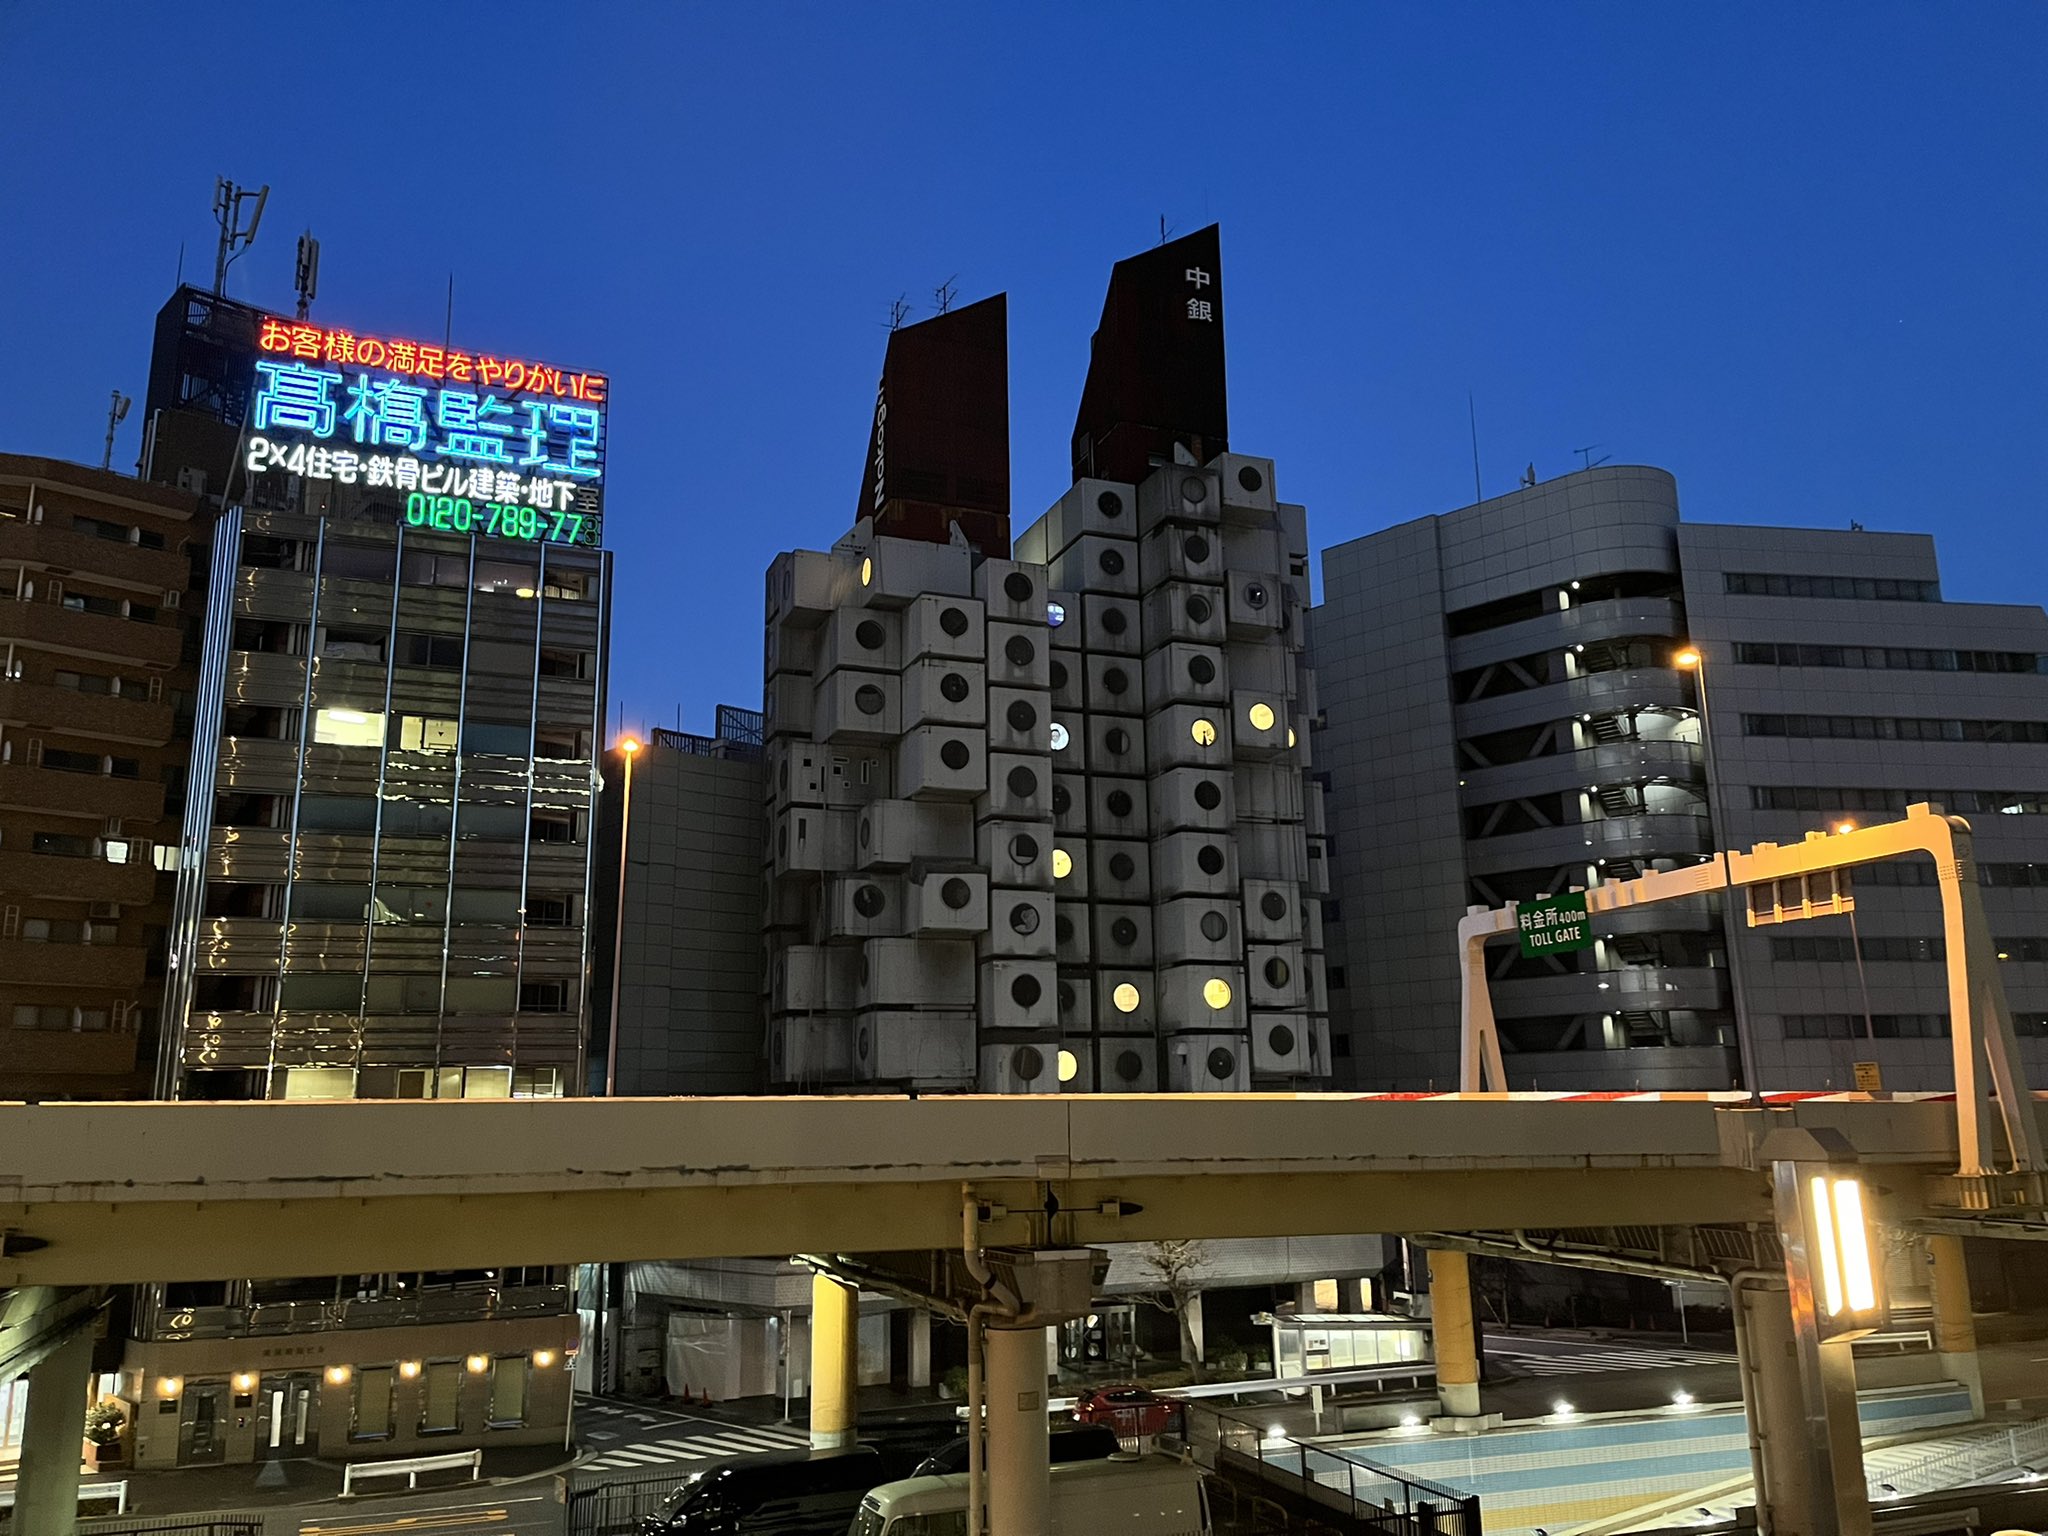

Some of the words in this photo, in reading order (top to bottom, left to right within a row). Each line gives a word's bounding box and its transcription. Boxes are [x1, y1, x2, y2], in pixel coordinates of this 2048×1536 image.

[1185, 266, 1212, 322] 中銀
[259, 320, 604, 401] お客様の満足をやりがいに
[407, 492, 598, 546] 0120-789-778
[1529, 932, 1553, 947] TOLL
[1555, 926, 1581, 943] GATE
